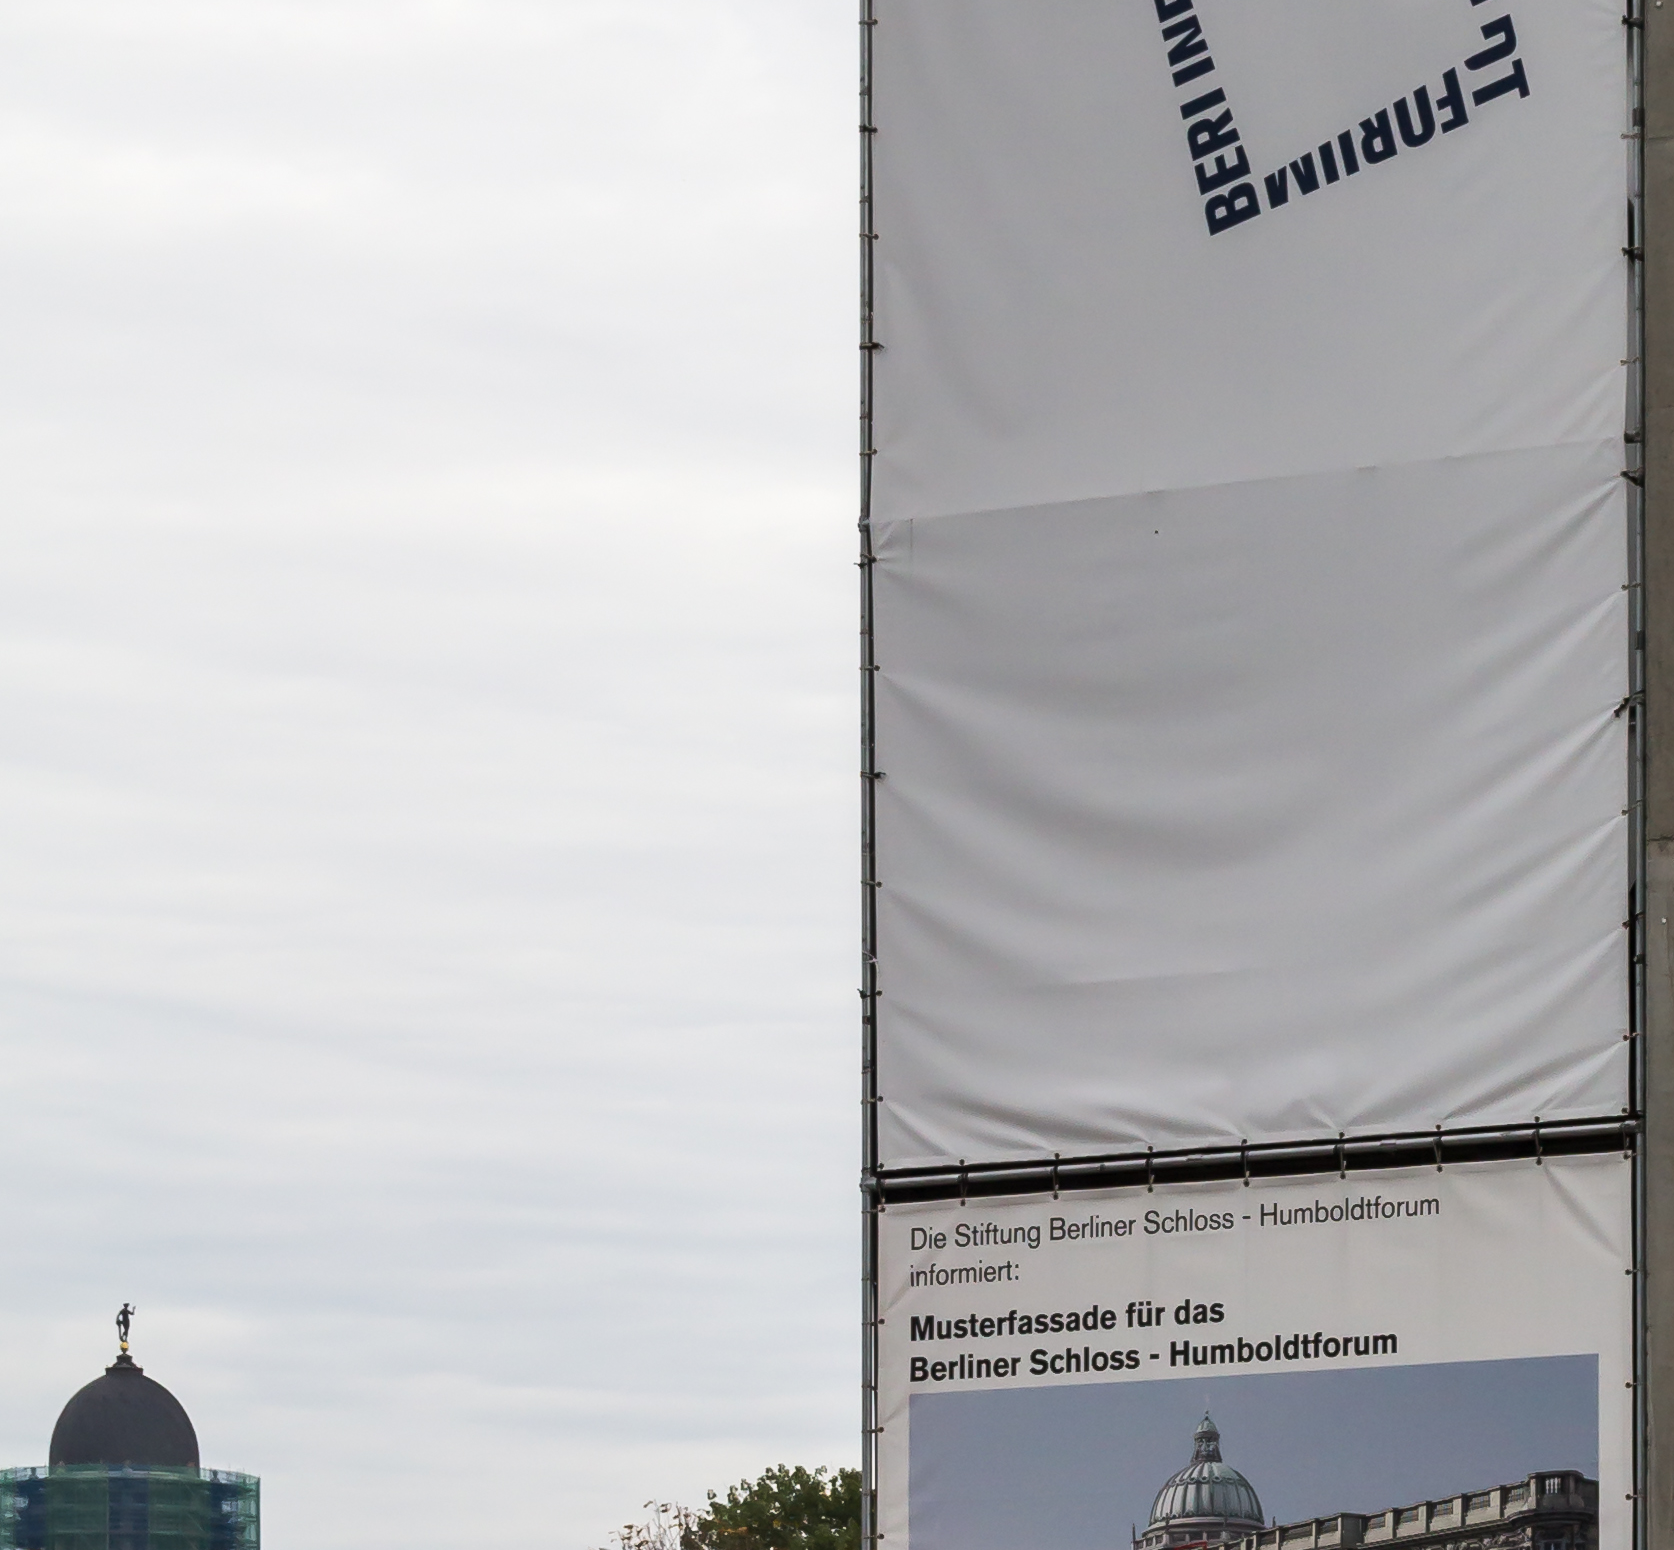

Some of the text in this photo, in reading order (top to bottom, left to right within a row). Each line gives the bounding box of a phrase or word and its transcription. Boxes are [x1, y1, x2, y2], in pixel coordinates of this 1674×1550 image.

[911, 1226, 947, 1250] Die
[954, 1222, 1041, 1249] Stiftung
[1049, 1215, 1136, 1241] Berliner
[1143, 1209, 1235, 1235] Schloss
[1260, 1196, 1440, 1227] Humboldtforum
[910, 1260, 1020, 1287] informiert:
[910, 1299, 1225, 1341] Musterfassade für das
[910, 1353, 1021, 1382] Berliner
[1029, 1347, 1141, 1375] Schloss
[1170, 1332, 1398, 1367] Humboldtforum
